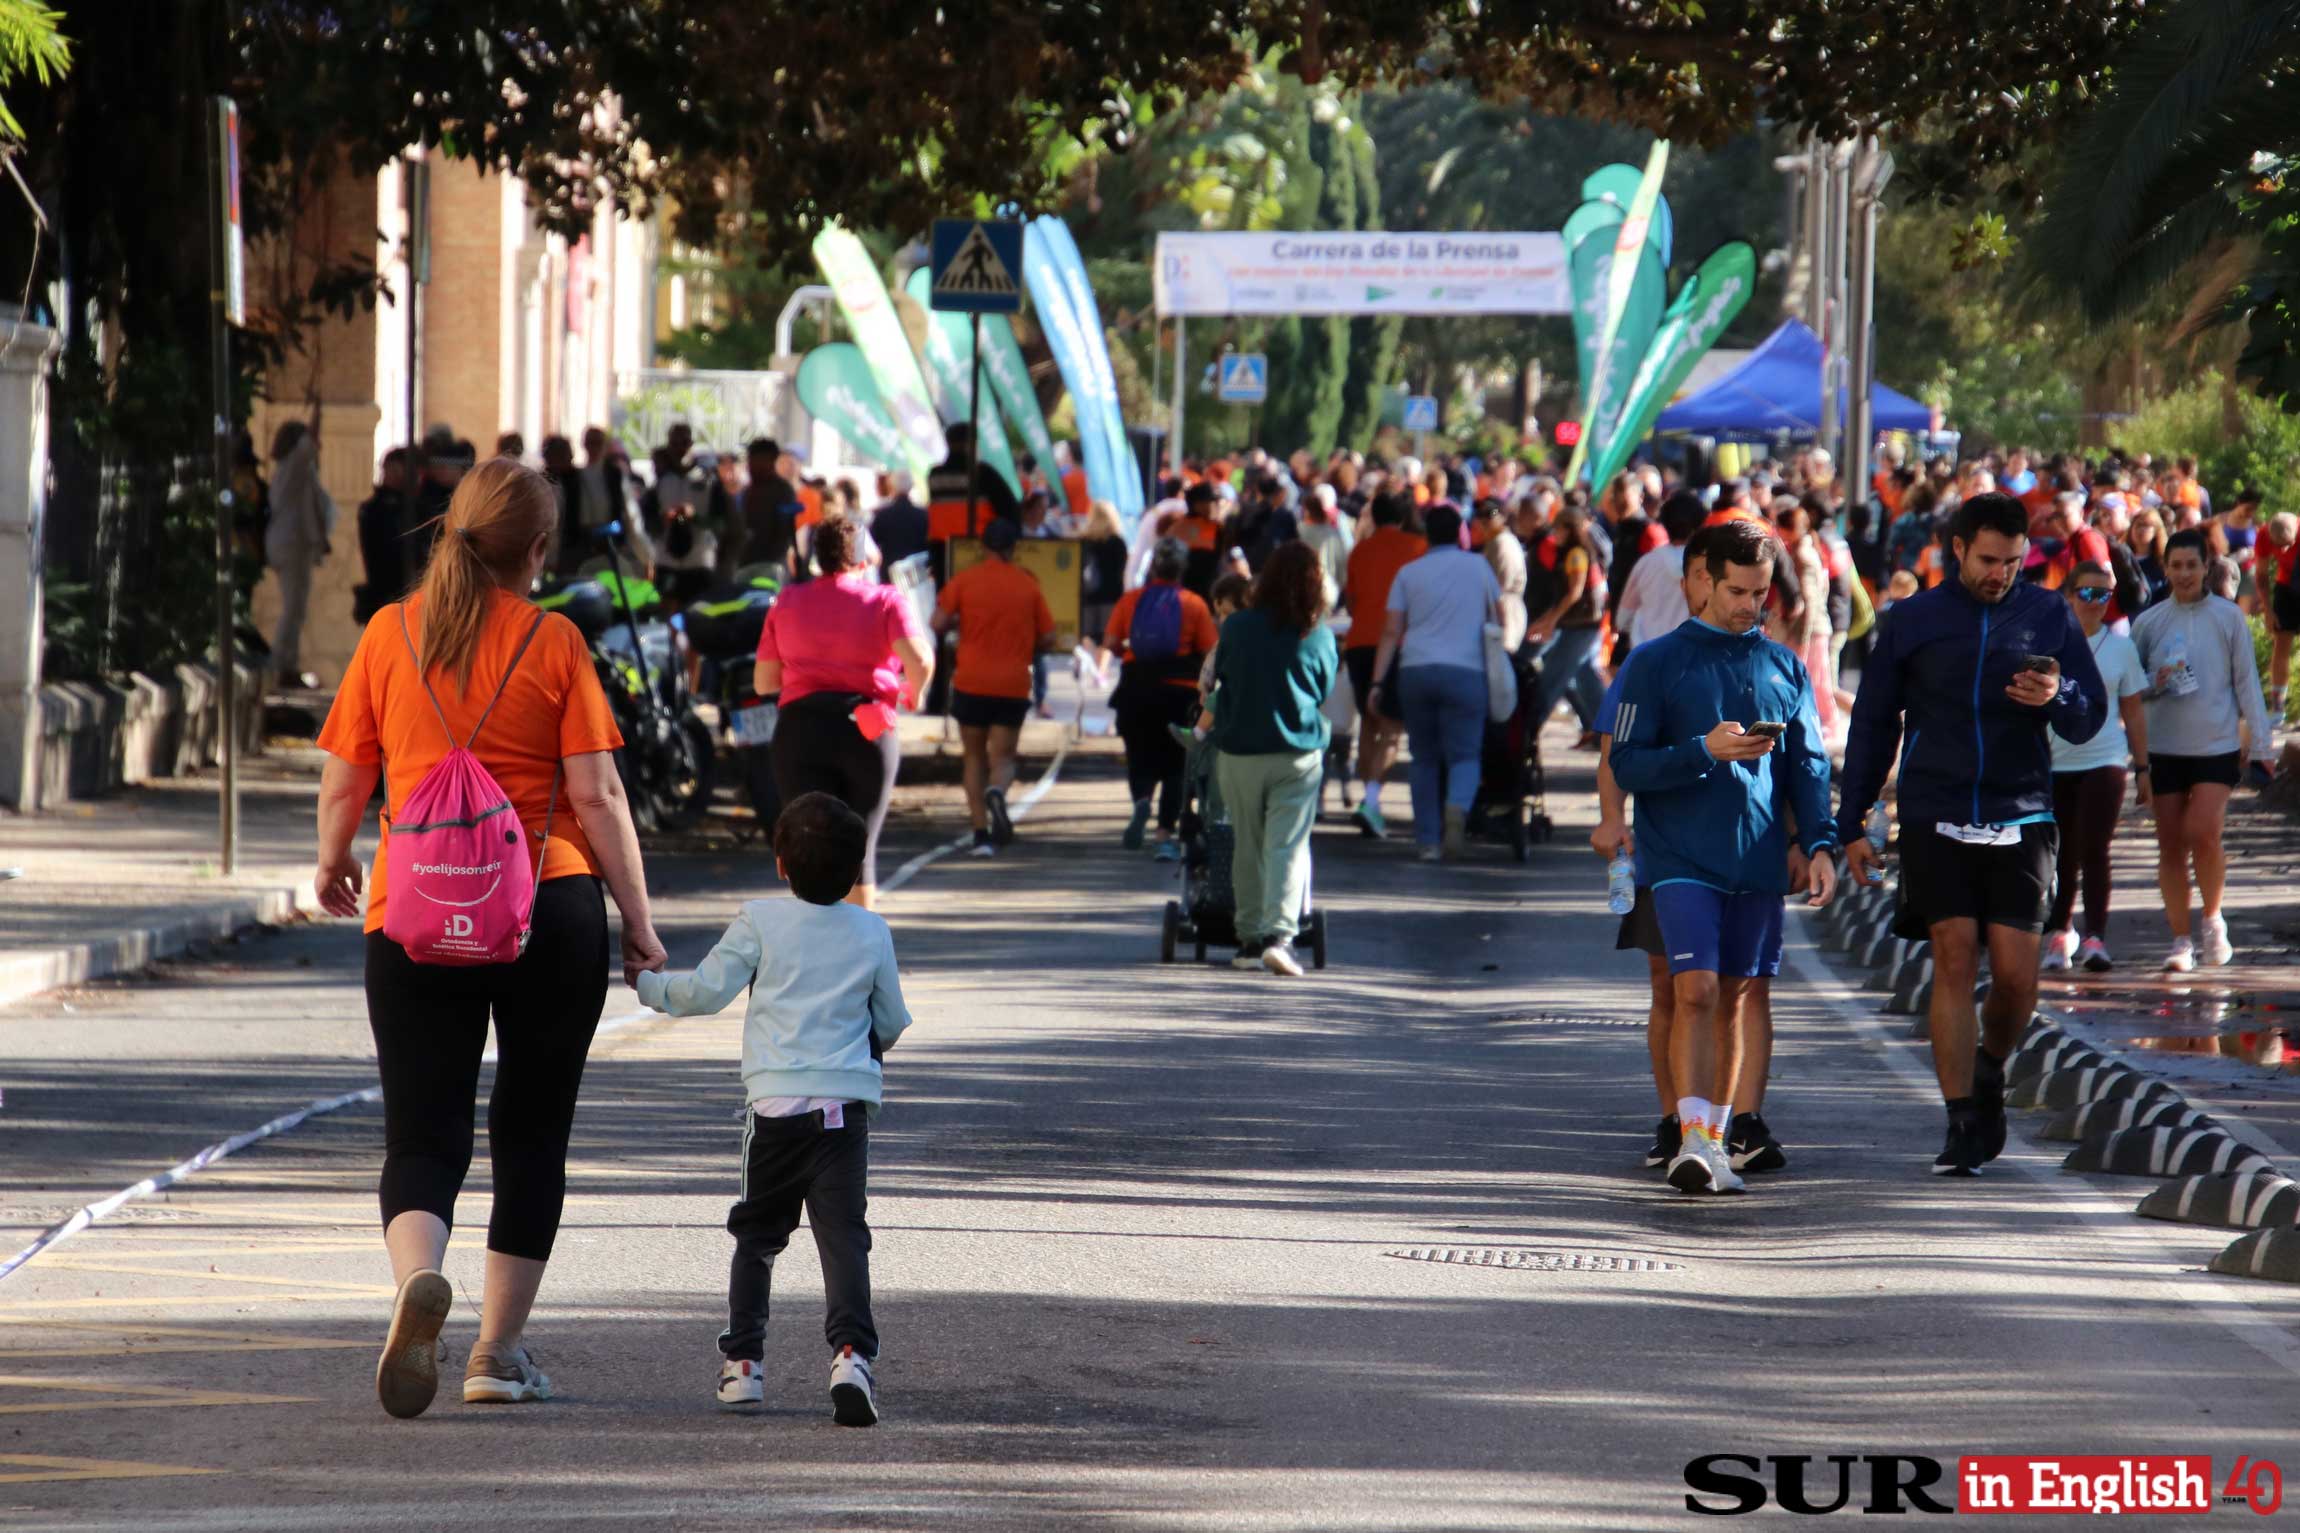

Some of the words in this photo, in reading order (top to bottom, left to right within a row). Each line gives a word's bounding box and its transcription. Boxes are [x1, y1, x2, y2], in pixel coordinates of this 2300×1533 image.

[1272, 239, 1363, 259] Carrera
[1370, 239, 1400, 259] de
[1408, 239, 1431, 259] la
[1437, 239, 1520, 259] Prensa
